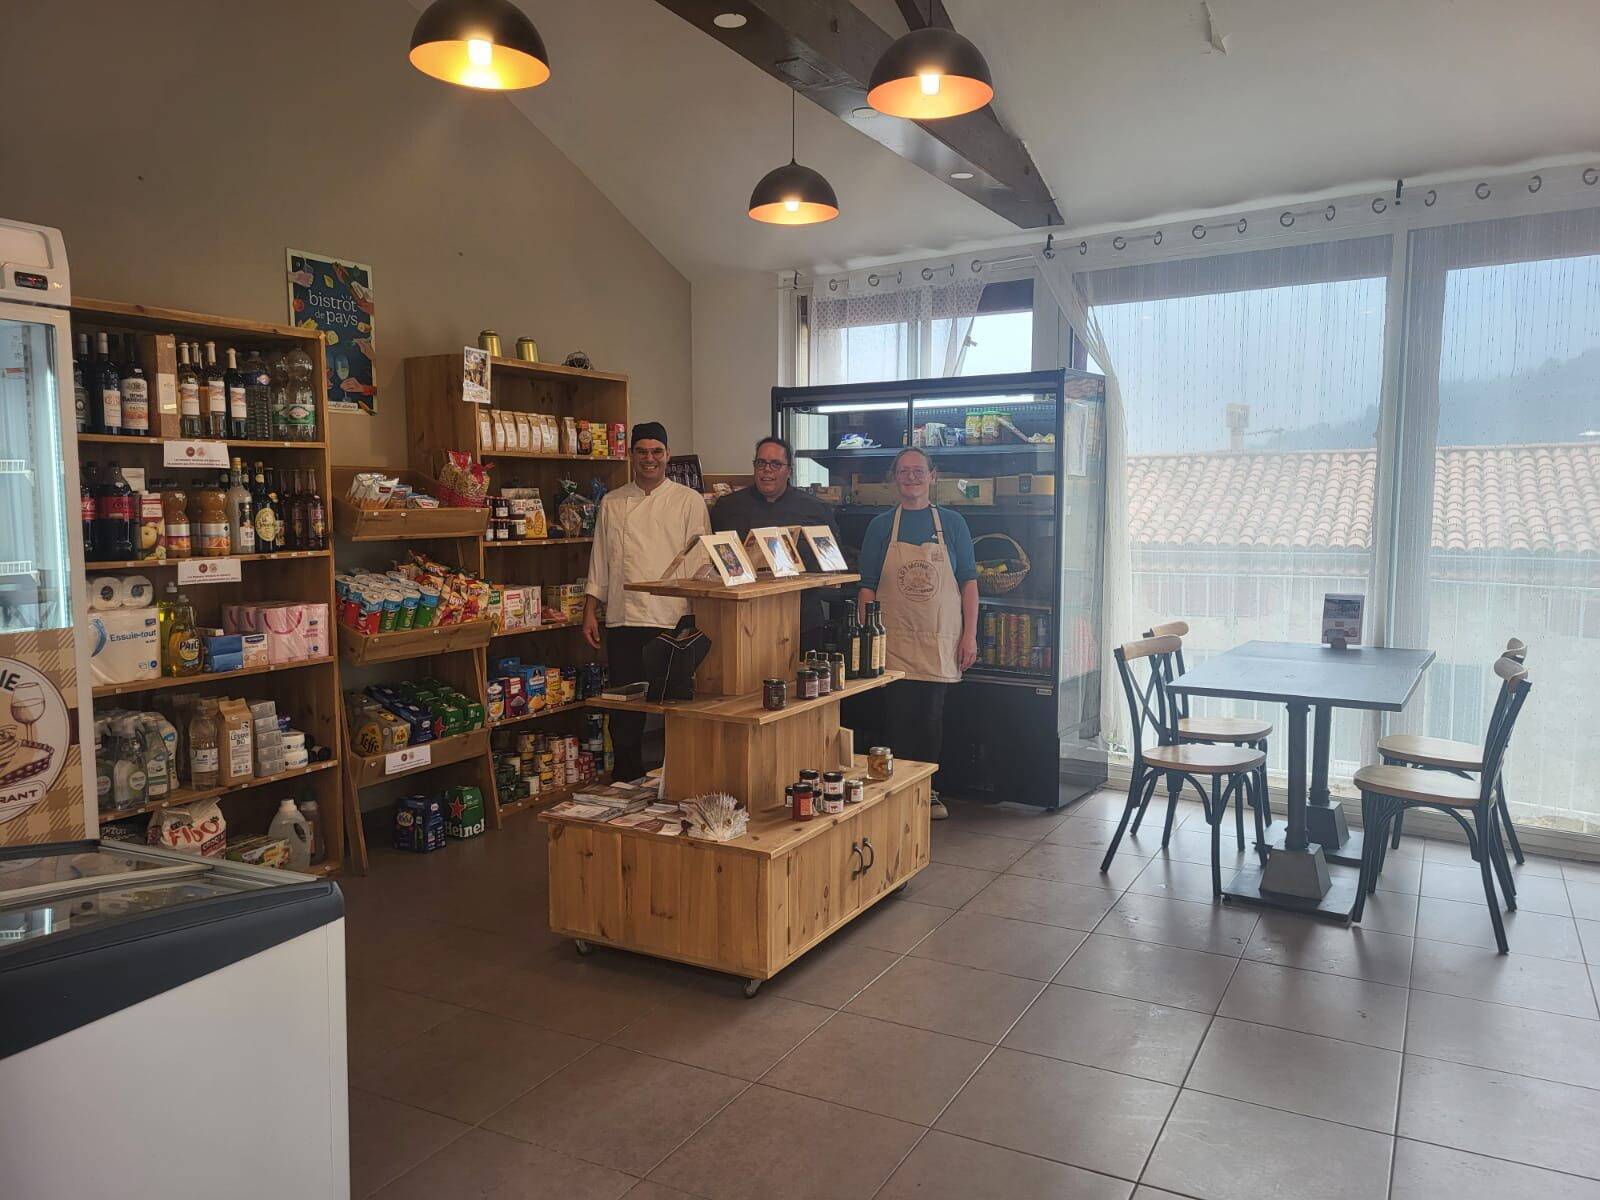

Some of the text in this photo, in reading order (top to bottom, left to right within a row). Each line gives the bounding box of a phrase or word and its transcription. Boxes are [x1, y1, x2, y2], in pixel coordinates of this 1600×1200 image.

[326, 310, 358, 328] pays
[109, 630, 156, 642] Essuie-tout
[360, 733, 379, 753] Leffe
